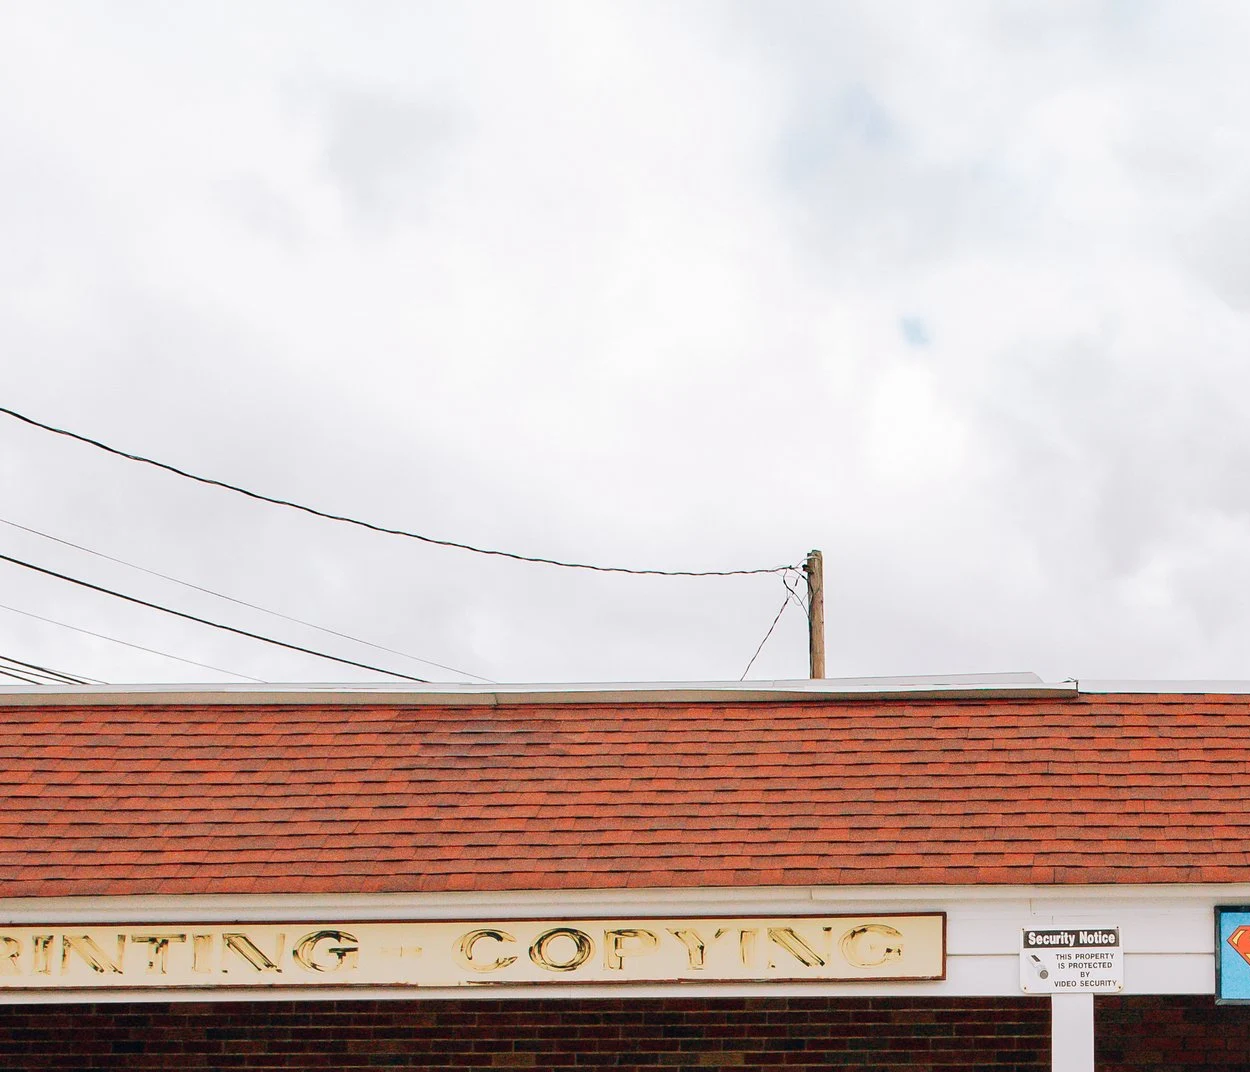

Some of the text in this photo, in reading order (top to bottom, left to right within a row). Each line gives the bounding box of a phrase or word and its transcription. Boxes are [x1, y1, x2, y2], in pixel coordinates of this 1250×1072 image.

[1028, 930, 1115, 947] Security Notice
[451, 923, 903, 972] COPYING
[1075, 952, 1115, 960] PROPERTY
